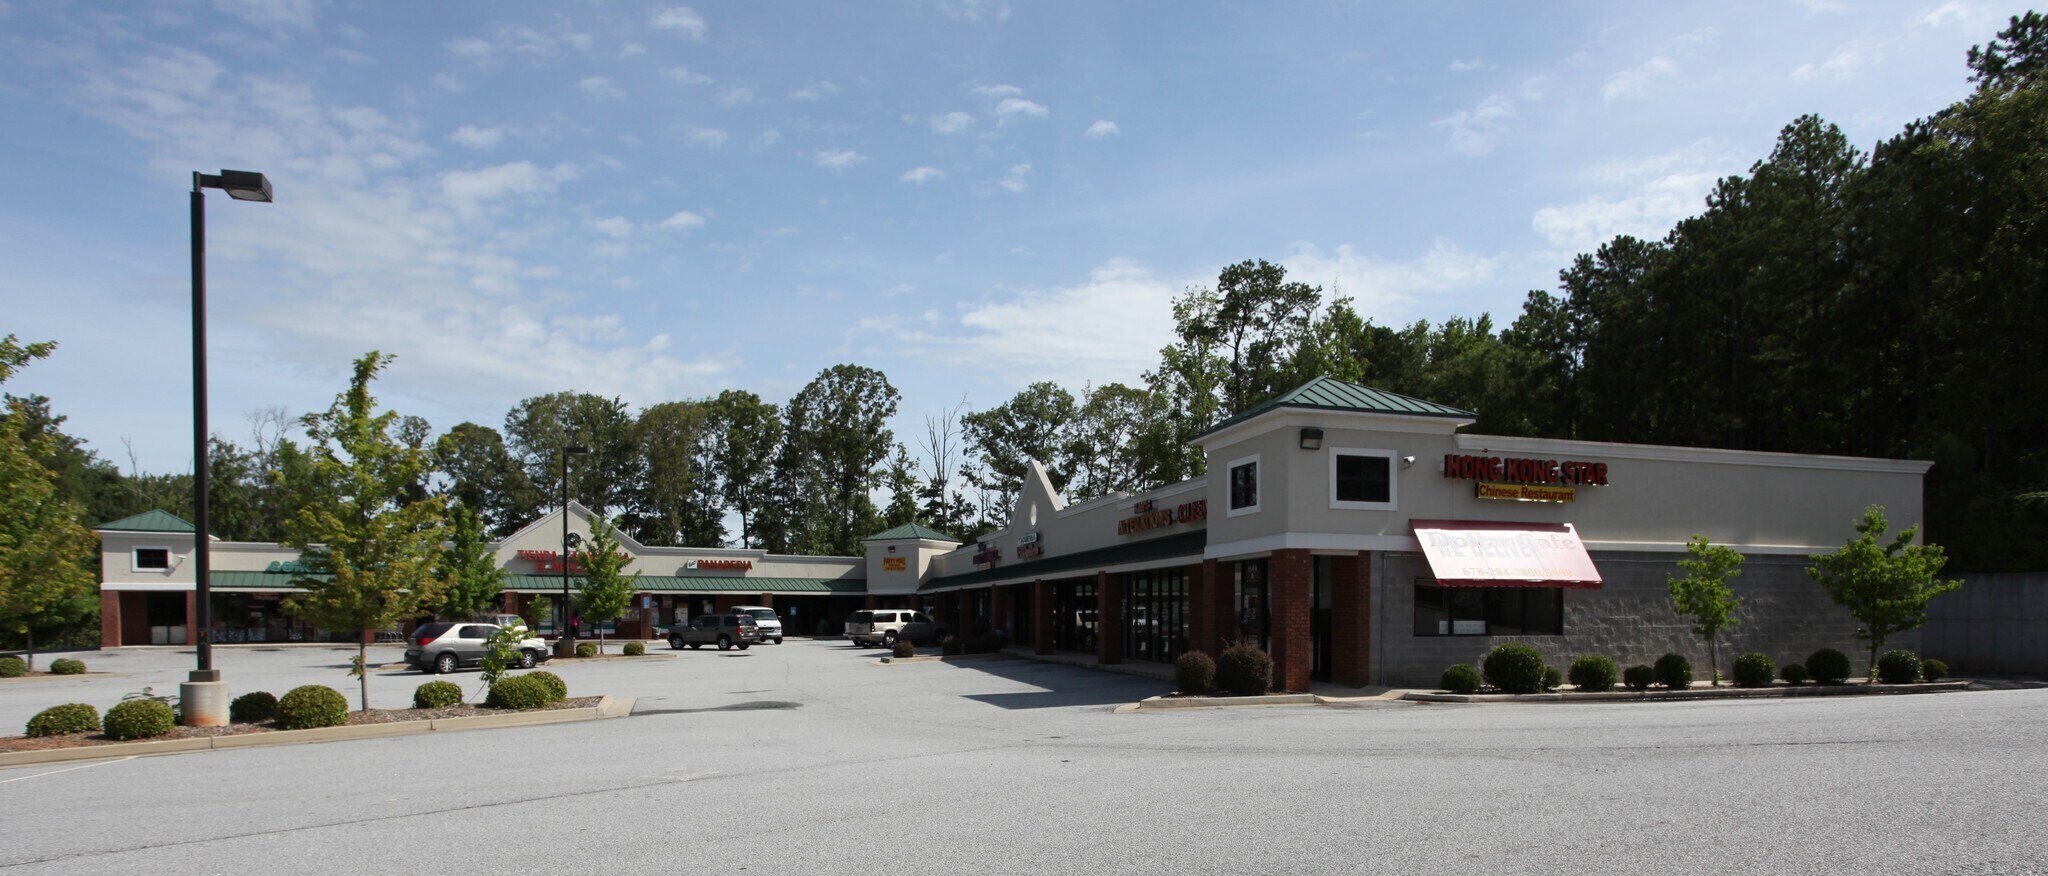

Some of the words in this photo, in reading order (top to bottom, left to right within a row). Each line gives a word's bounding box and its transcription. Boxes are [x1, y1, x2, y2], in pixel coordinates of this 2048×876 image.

[1444, 454, 1503, 481] HONG
[1504, 457, 1560, 484] KONG
[1562, 461, 1609, 486] STAR
[1479, 485, 1519, 498] Chinese
[1521, 486, 1574, 501] Restaurant
